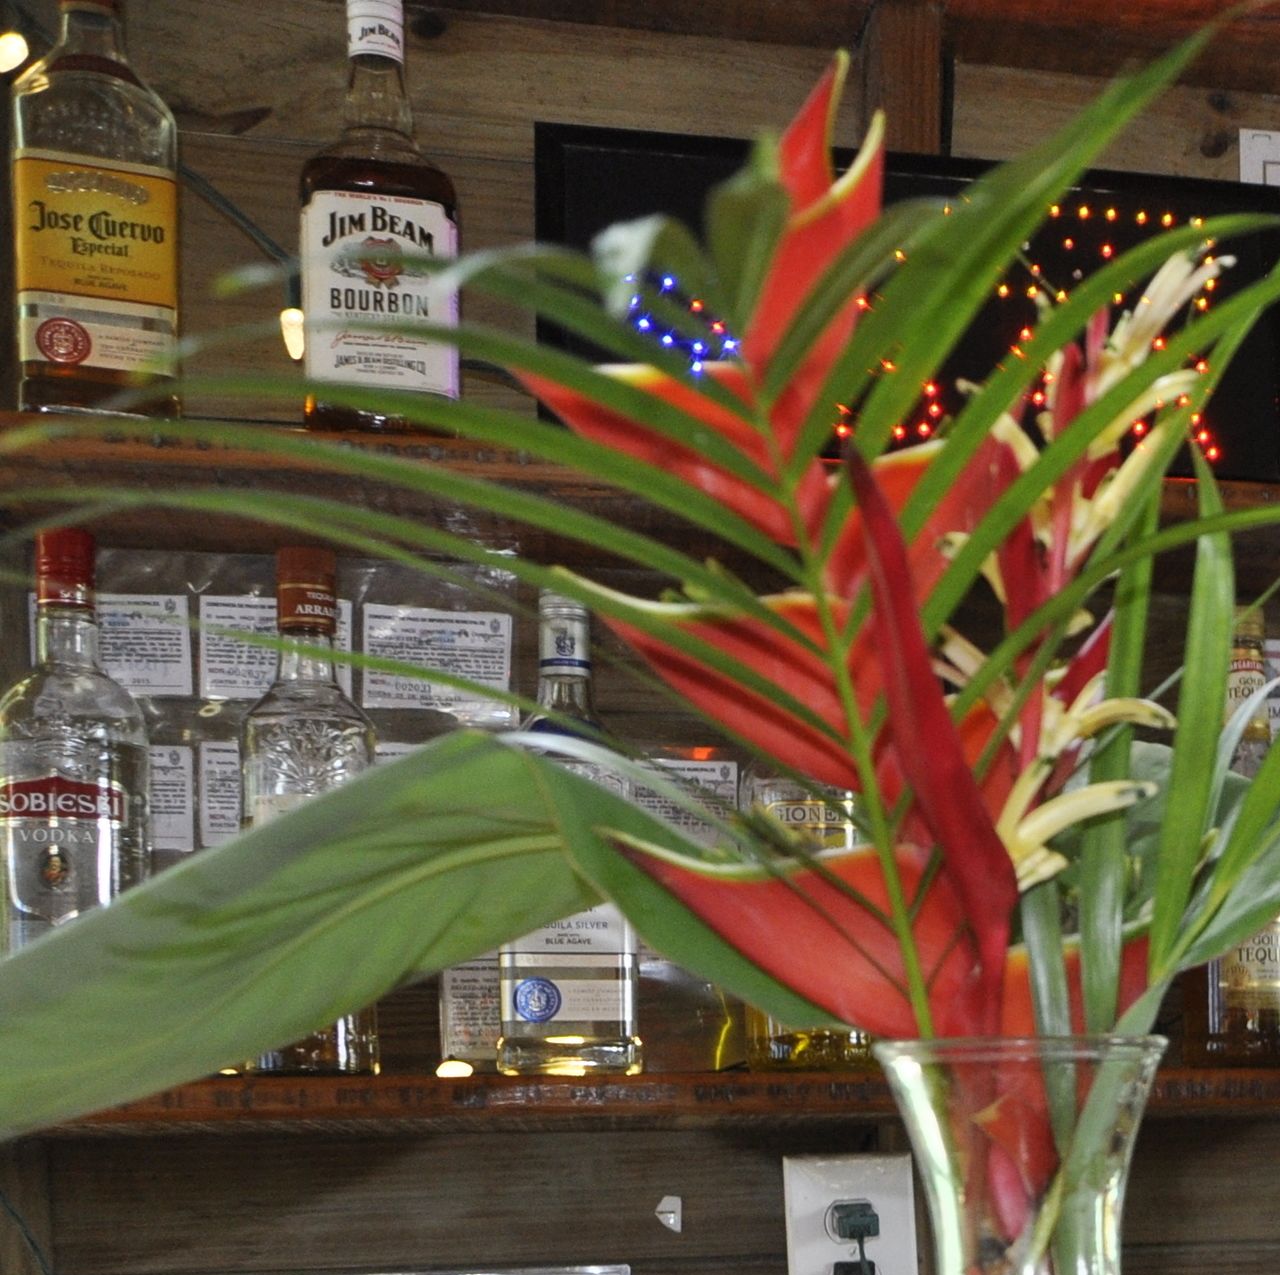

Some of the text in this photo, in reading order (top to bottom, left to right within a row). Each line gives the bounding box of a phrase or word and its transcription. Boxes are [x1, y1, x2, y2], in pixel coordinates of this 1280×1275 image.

[29, 201, 165, 244] Jose Cuervo
[322, 205, 435, 255] JIM BEAM
[69, 236, 129, 257] Especial
[330, 287, 430, 318] BOURBON
[19, 829, 95, 844] VODKA
[575, 921, 609, 930] SILVER
[545, 937, 592, 946] BLUE AGAVE
